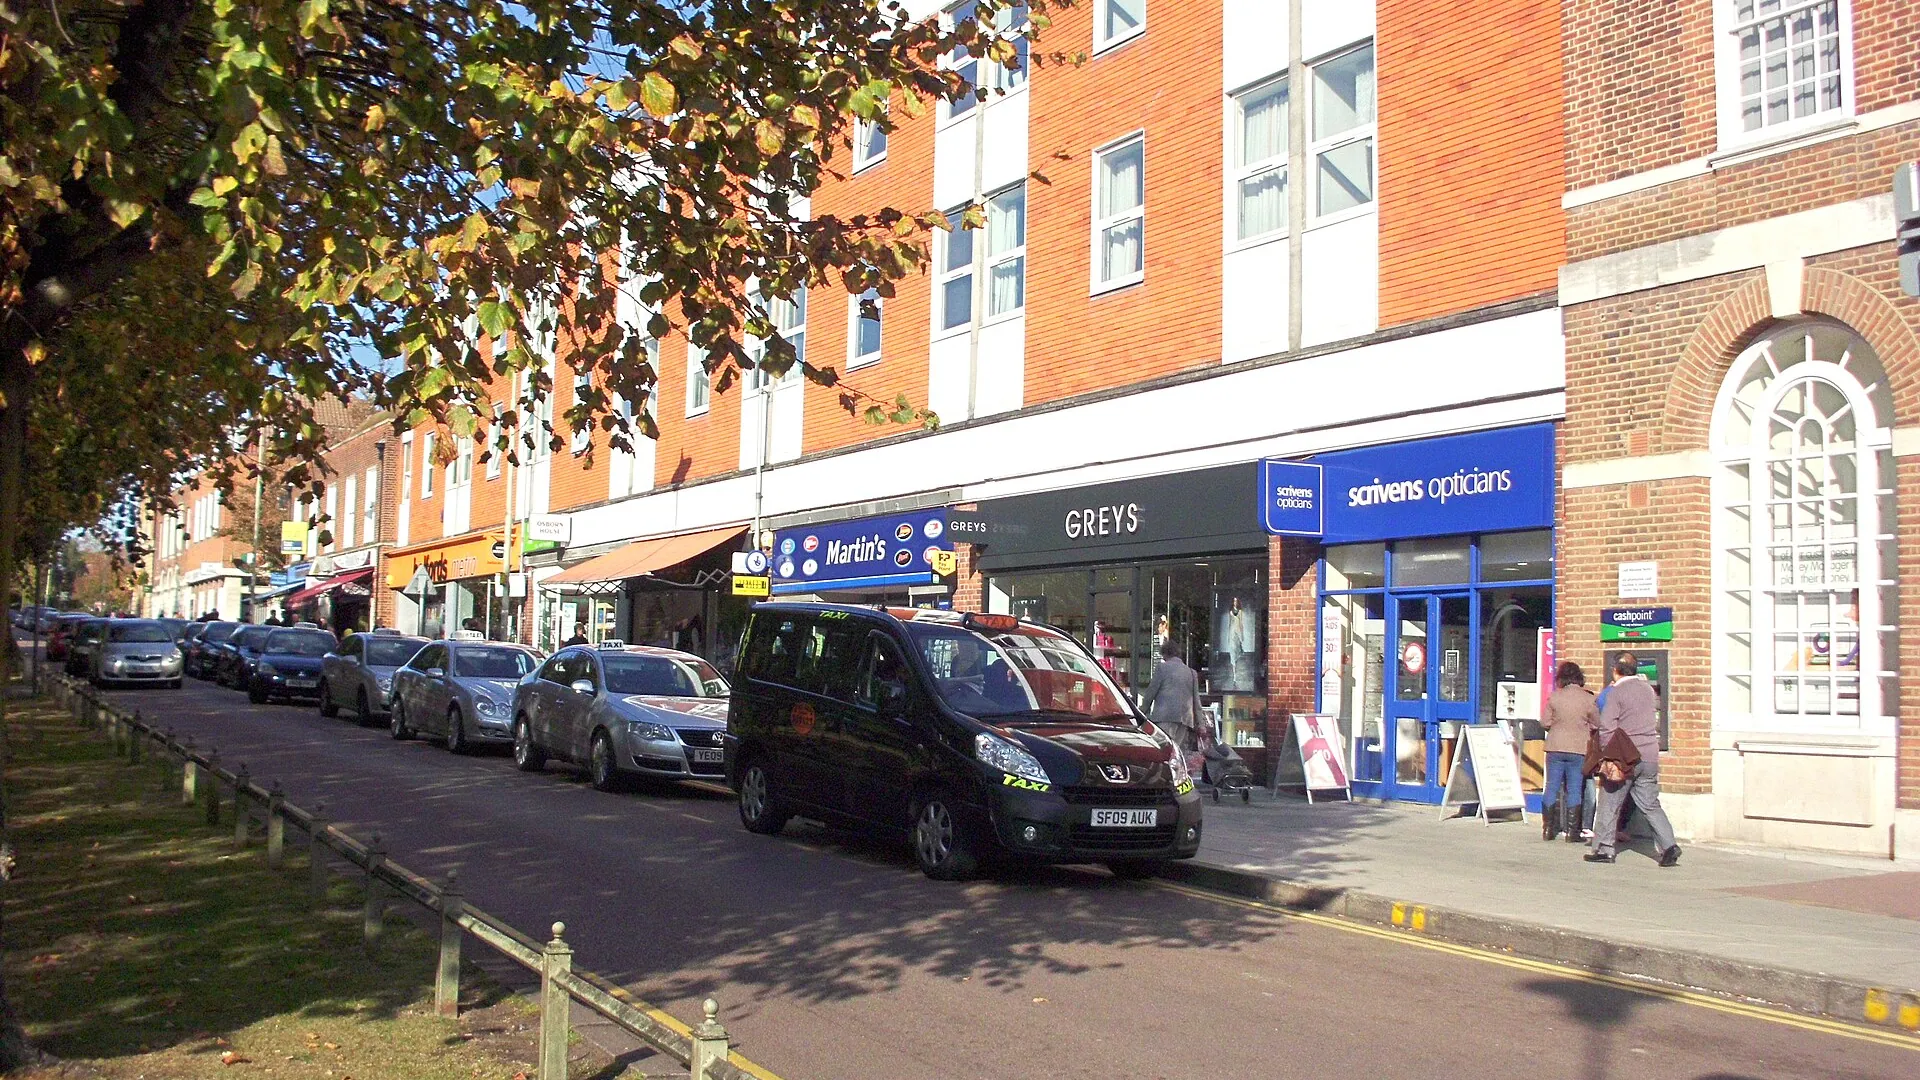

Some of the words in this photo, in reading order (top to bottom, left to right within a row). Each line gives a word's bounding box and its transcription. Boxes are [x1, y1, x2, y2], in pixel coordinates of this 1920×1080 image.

[1276, 485, 1313, 498] scrivens
[1348, 477, 1423, 507] scrivens
[1428, 467, 1511, 504] opticians
[1276, 497, 1313, 509] opticians
[950, 520, 987, 533] GREYS
[1064, 502, 1139, 539] GREYS
[825, 533, 886, 566] Martin's
[452, 556, 477, 579] metro
[820, 610, 850, 619] TAXI
[1613, 609, 1653, 622] cashpoint
[1002, 773, 1050, 792] TAXI
[1096, 811, 1127, 824] SF09
[1130, 811, 1153, 824] AUK
